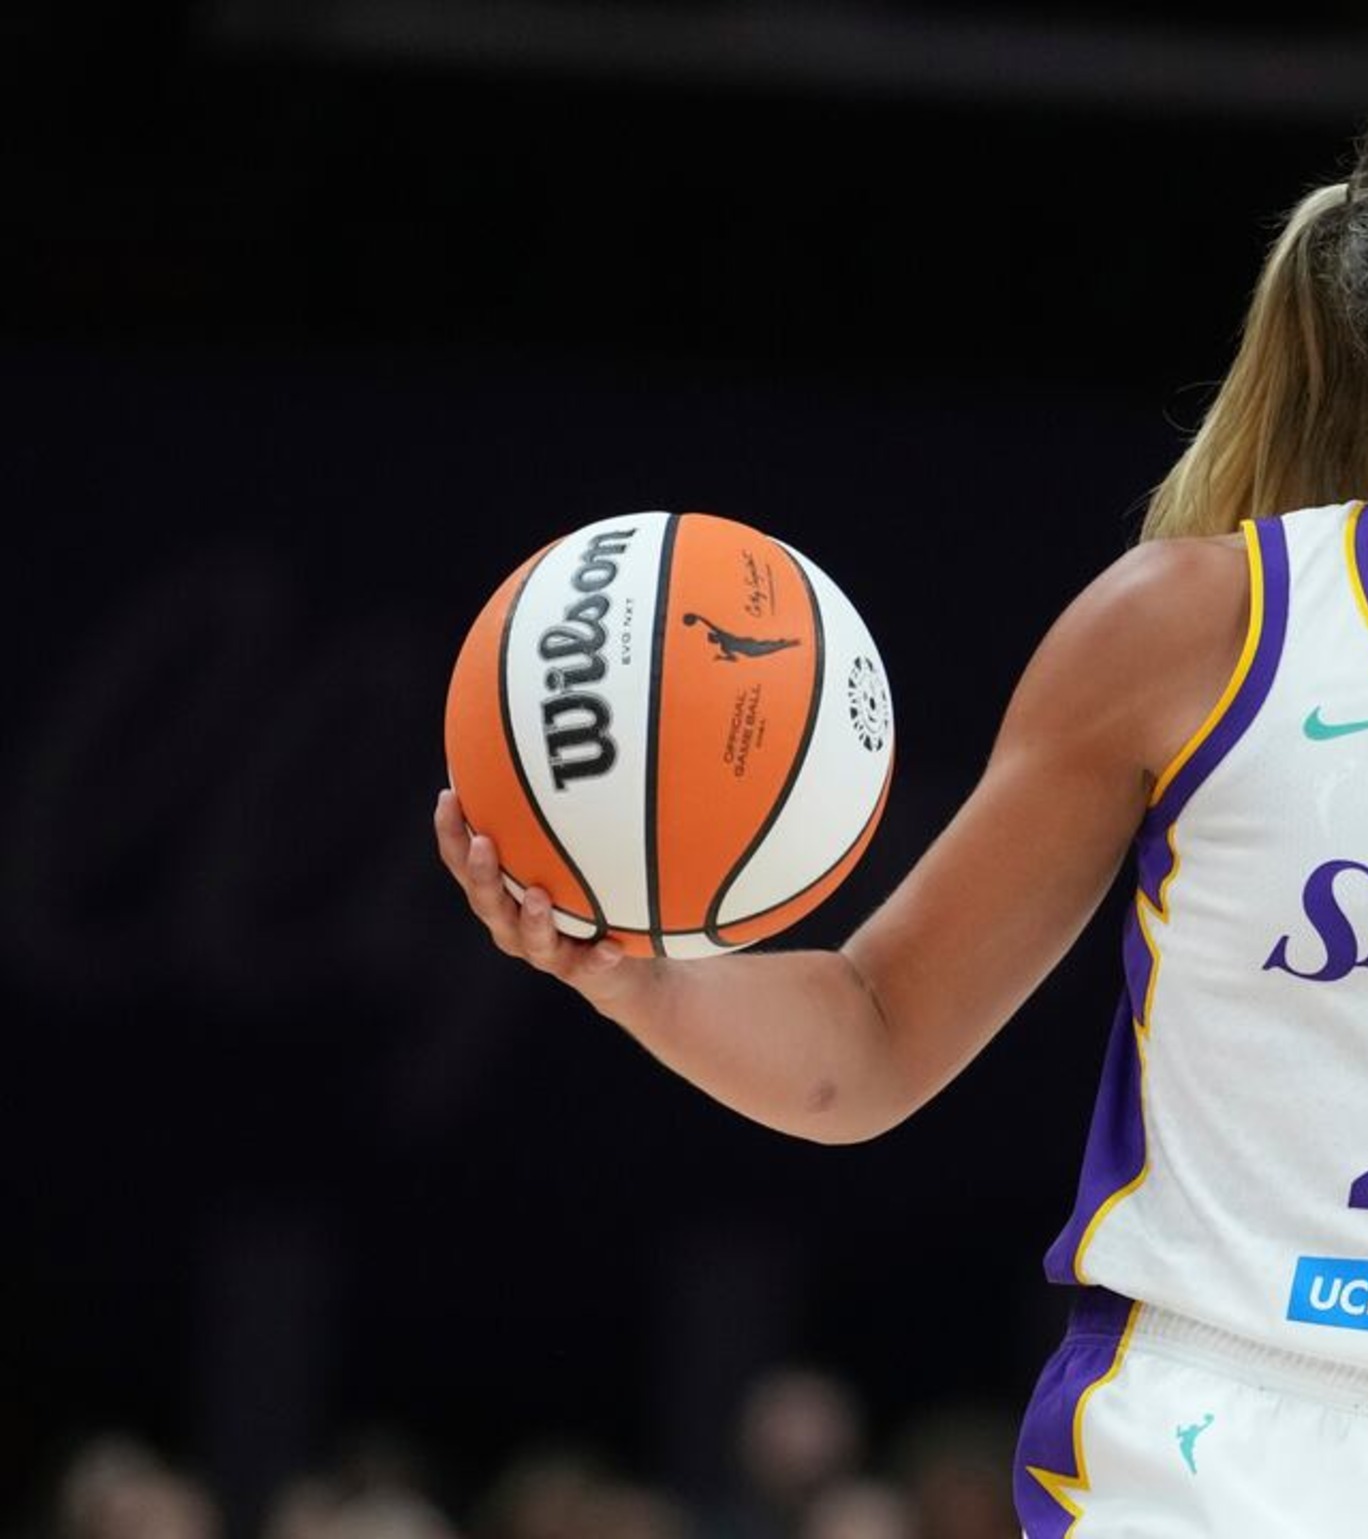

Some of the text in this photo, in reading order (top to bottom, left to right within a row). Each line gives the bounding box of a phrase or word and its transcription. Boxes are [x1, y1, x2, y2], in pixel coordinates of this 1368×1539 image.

[539, 527, 637, 791] Wilson
[621, 632, 632, 666] EVO
[723, 690, 747, 764] OFFICIAL
[744, 684, 762, 726] BALL
